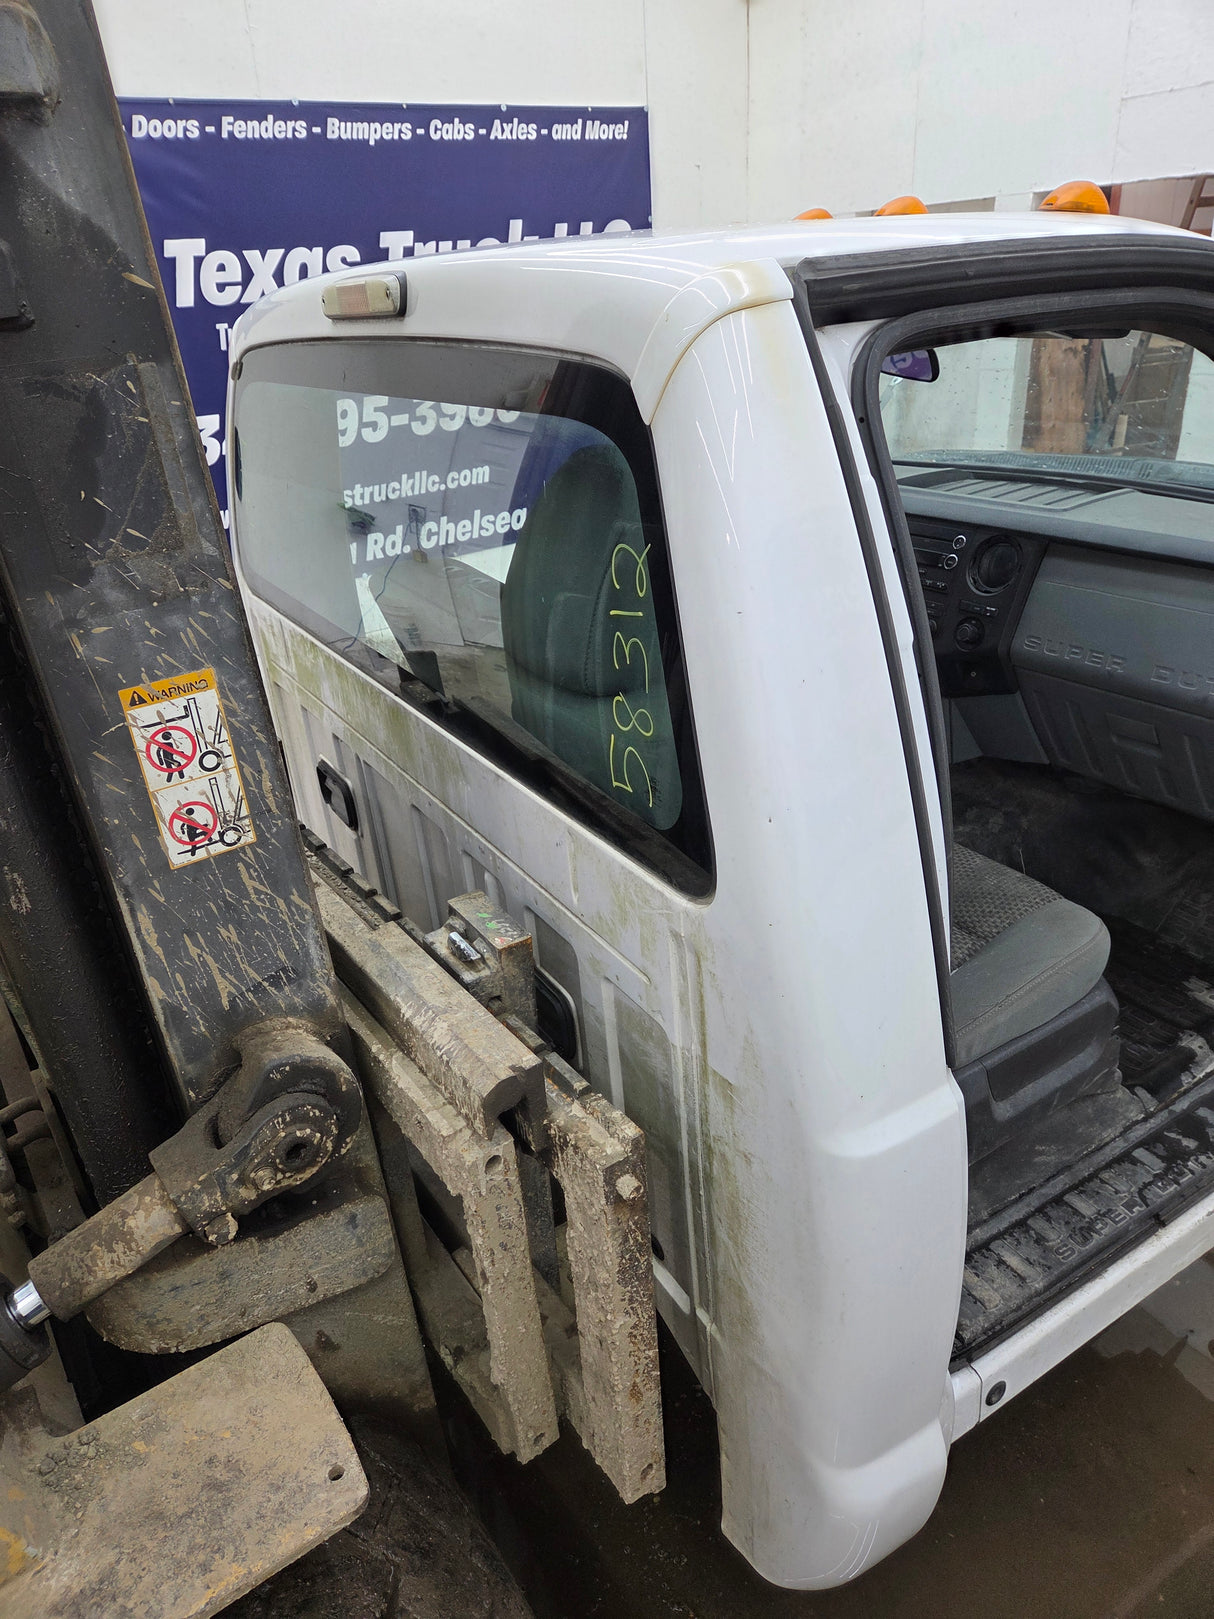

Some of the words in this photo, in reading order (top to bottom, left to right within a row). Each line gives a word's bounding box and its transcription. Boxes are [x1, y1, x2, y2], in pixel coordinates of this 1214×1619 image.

[131, 114, 200, 139] Doors
[221, 114, 307, 140] Fenders
[326, 117, 412, 145] Bumpers
[429, 117, 475, 140] Cabs
[490, 117, 537, 141] Axles
[551, 118, 583, 140] and
[585, 120, 629, 140] More!
[366, 524, 411, 561] Rd.
[420, 507, 527, 549] Chelsea
[1023, 634, 1128, 673] SUPER
[147, 678, 209, 703] WARNING
[609, 543, 654, 808] 58312
